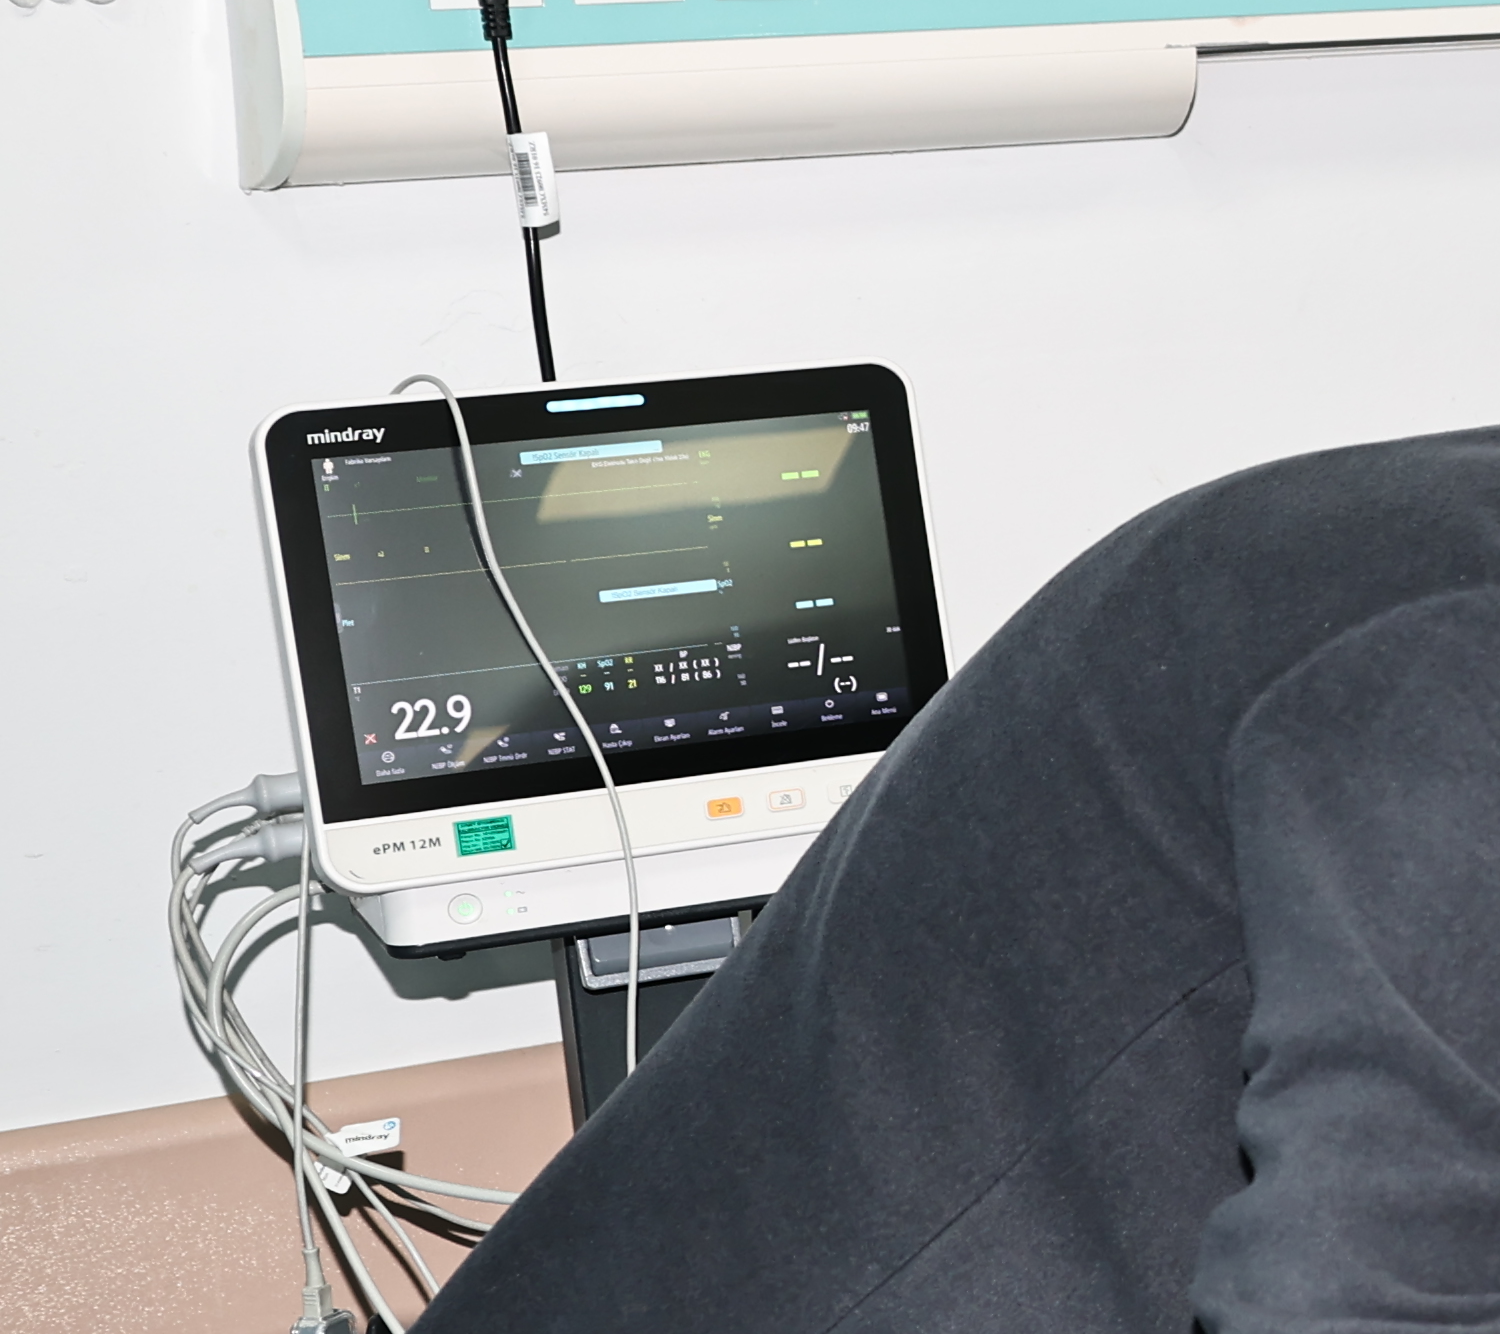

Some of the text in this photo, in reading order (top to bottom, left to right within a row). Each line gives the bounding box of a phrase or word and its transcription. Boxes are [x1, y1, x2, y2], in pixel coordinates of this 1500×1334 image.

[847, 422, 870, 433] 09:47
[306, 427, 386, 445] mindray
[597, 659, 613, 668] SpO2
[579, 680, 637, 694] 129 91 21
[390, 694, 472, 741] 22.9
[373, 837, 442, 855] ePM 12M
[345, 1133, 390, 1144] mindray
